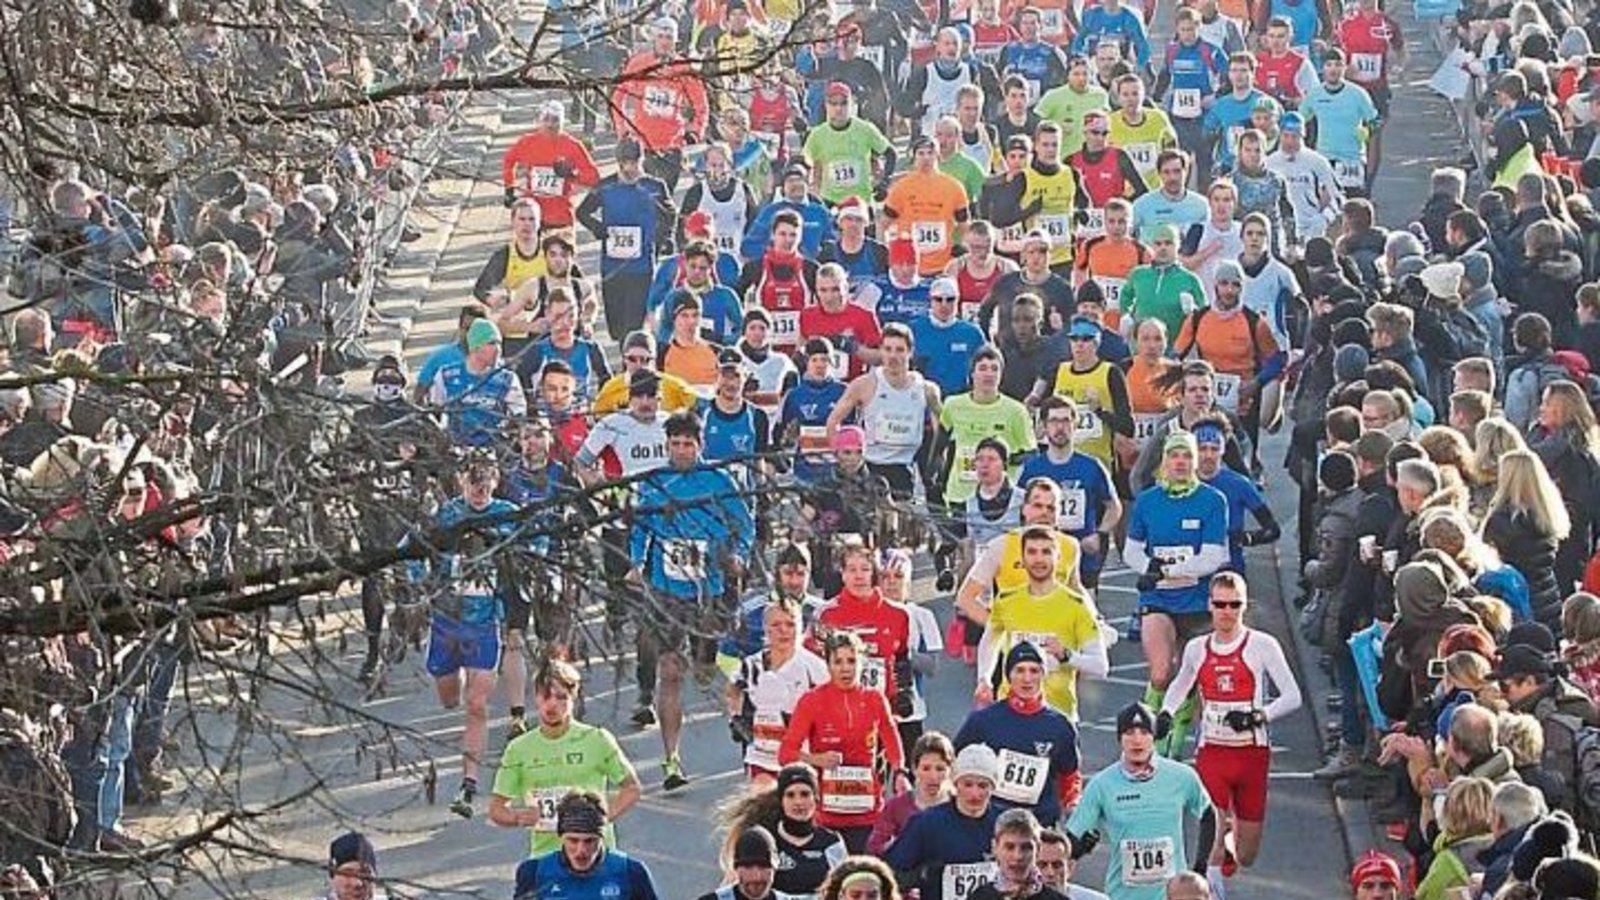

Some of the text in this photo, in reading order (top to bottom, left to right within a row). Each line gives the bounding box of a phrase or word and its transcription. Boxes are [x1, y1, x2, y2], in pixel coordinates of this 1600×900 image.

[919, 229, 940, 243] 345
[630, 443, 665, 460] do it
[1003, 762, 1037, 787] 618
[1132, 850, 1165, 870] 104
